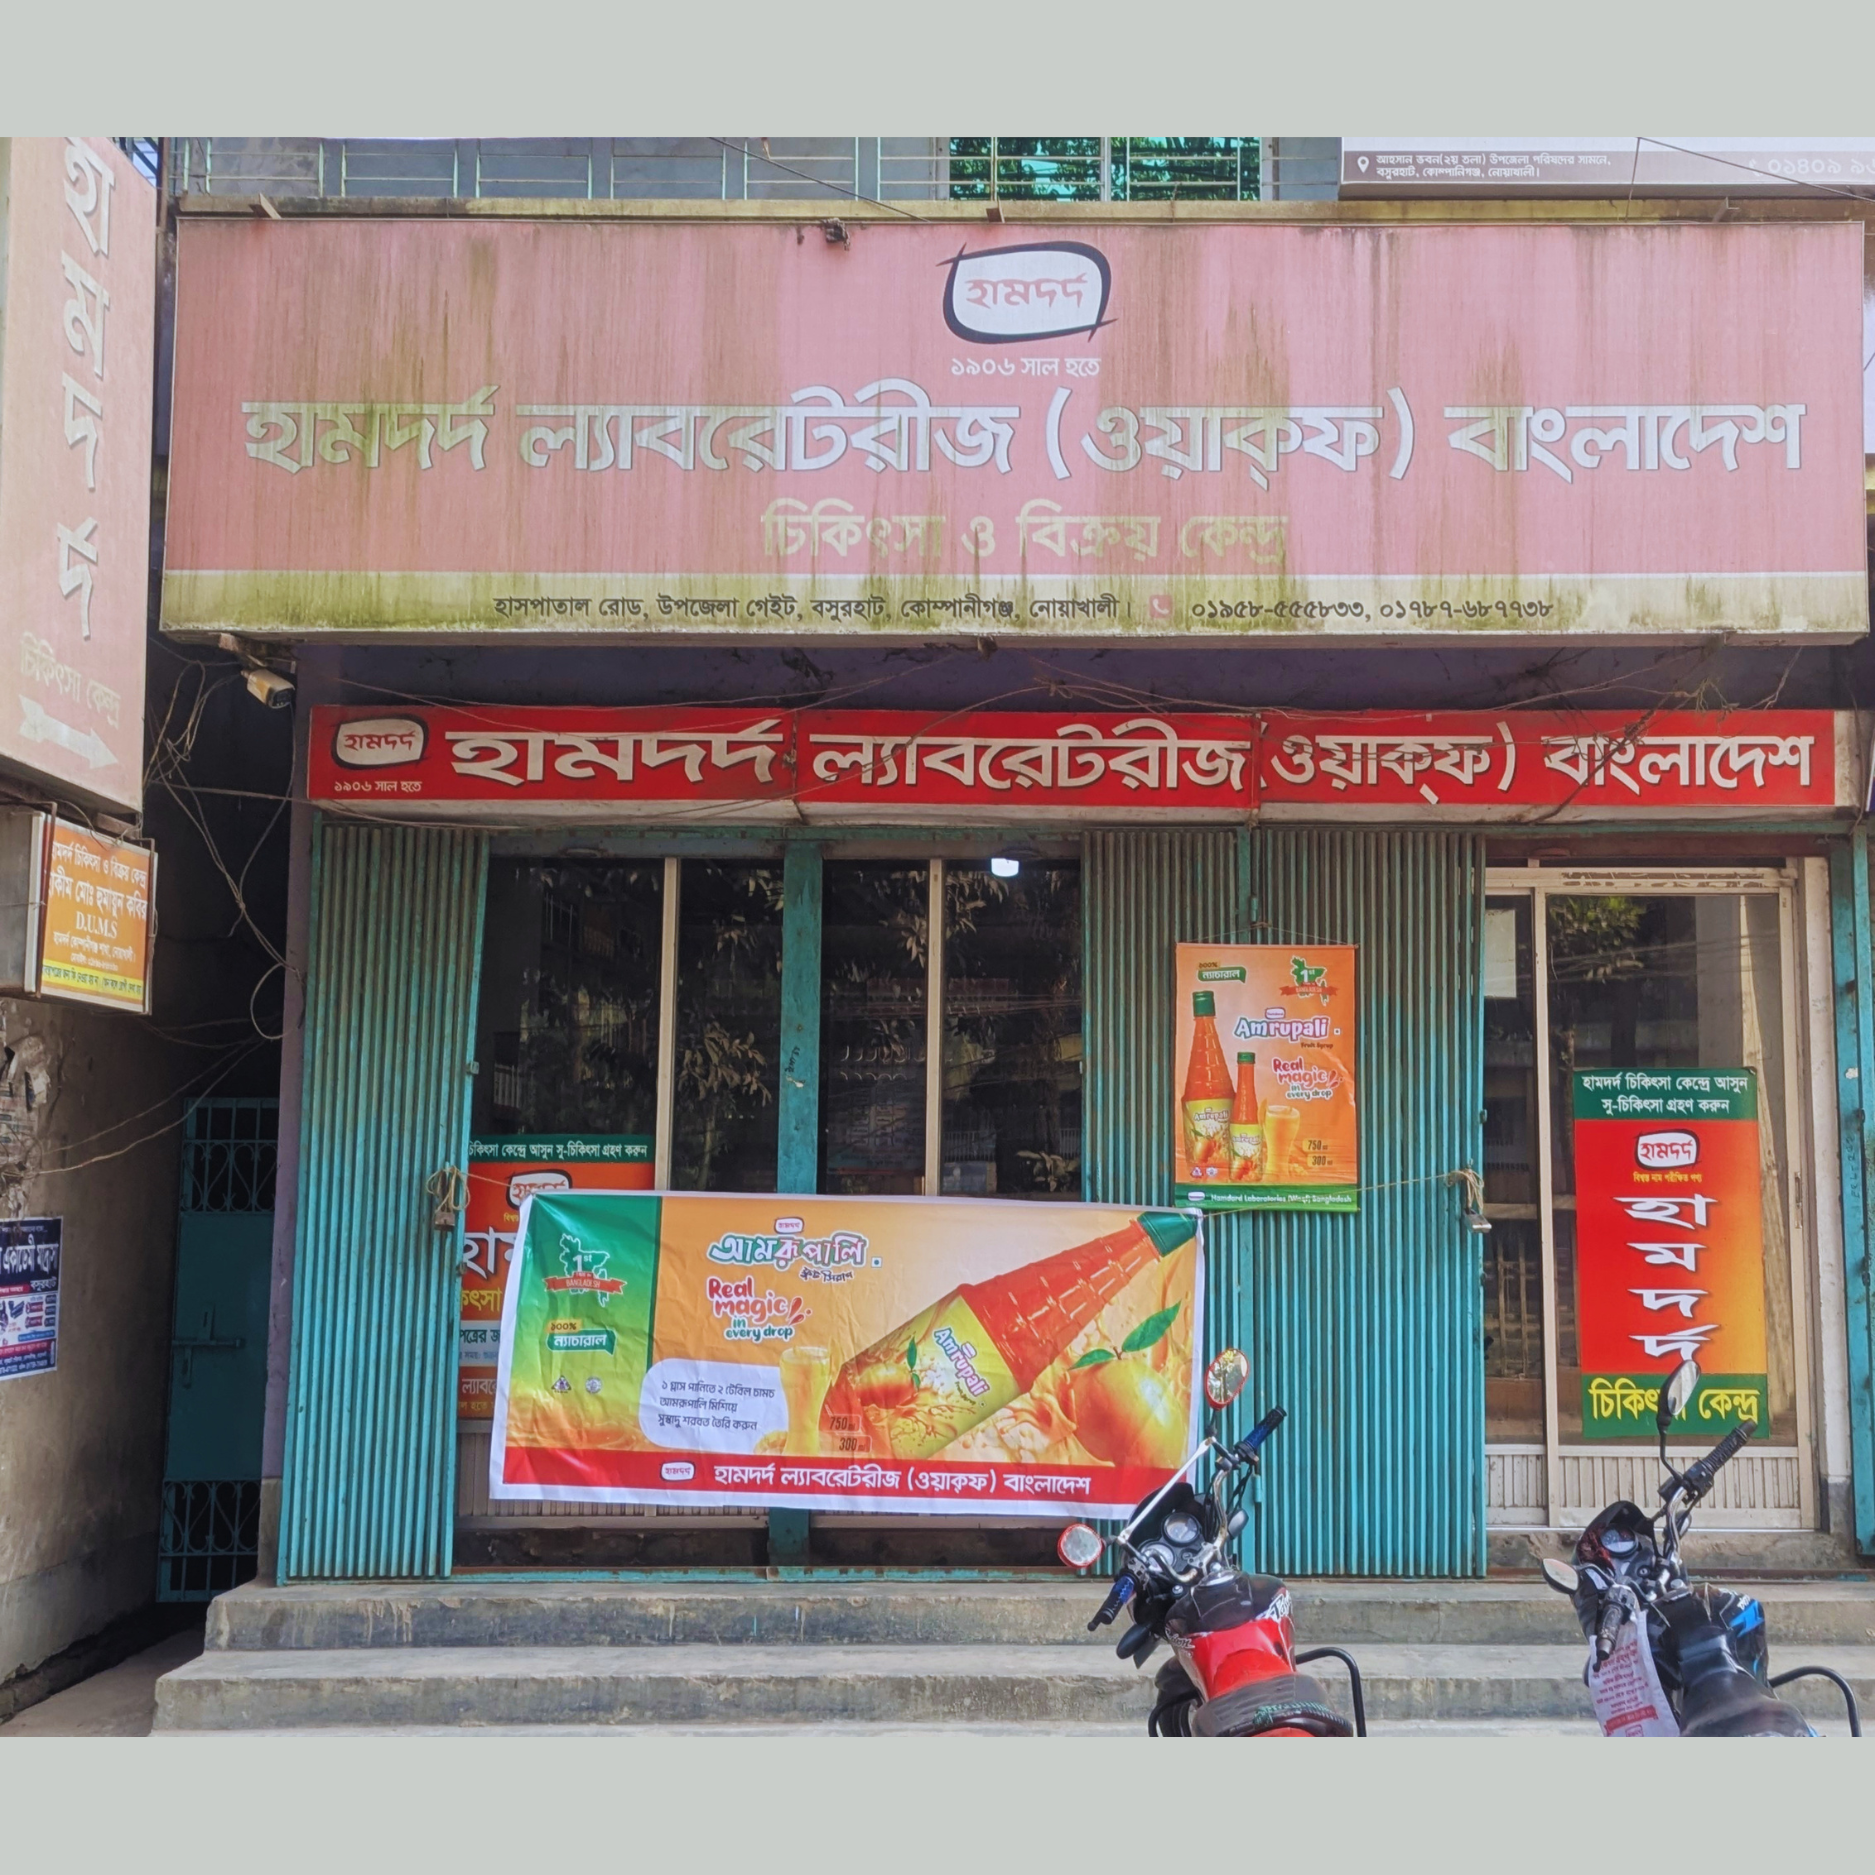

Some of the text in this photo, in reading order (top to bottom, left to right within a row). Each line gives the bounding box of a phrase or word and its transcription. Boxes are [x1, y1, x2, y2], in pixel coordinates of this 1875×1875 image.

[1376, 155, 1412, 165] আহসান
[1489, 152, 1529, 166] উপজেলা
[1533, 152, 1575, 166] পরিষদের
[1577, 154, 1611, 166] সামনে,
[1767, 158, 1842, 174] ০১৪০৯
[1376, 166, 1420, 180] বসুরহাট,
[964, 272, 1088, 310] হামদর্দ
[950, 356, 1102, 378] ১৯০৬ সাল হতে
[241, 384, 500, 475] হামদর্দ
[515, 376, 1020, 475] ল্যাবরেটরীজ
[1443, 402, 1808, 485] বাংলাদেশ
[761, 498, 1288, 565] চিকিৎসা ও বিক্রয় কেন্দ্র
[493, 594, 592, 619] হাসপাতাল
[598, 594, 649, 622] রোড,
[655, 592, 739, 618] উপজেলা
[746, 592, 803, 622] গেইট,
[811, 593, 892, 622] বসুরহাট,
[900, 592, 1021, 622] কোম্পানীগঞ্জ,
[1191, 600, 1371, 623] ০১৯৫৮-৫৫৫৮৩৩,
[1379, 599, 1554, 619] ০১৭৮৭-৬৮৭৭৩৮
[343, 730, 416, 752] হামদর্দ
[444, 718, 784, 788] হামদর্দ
[809, 717, 1252, 792] ল্যাবরেটরীজ
[1540, 735, 1815, 796] বাংলাদেশ
[334, 780, 423, 792] ১৯০৬ সাল হতে
[75, 910, 118, 940] D.U.M.S
[1202, 969, 1240, 980] ন্যাচারাল
[1235, 1017, 1329, 1042] Amrupali
[1272, 1056, 1303, 1072] Real
[1277, 1066, 1328, 1088] magic
[1581, 1071, 1748, 1093] হামদর্দ চিকিৎসা কেন্দ্রে আসুন
[1286, 1088, 1332, 1100] every drop
[1600, 1094, 1730, 1116] সু-চিকিৎসা গ্রহণ করুন
[501, 1141, 527, 1158] কেন্দ্রে
[529, 1142, 554, 1160] আসুন
[555, 1140, 600, 1161] সু-চিকিৎসা
[601, 1143, 622, 1159] গ্রহণ
[624, 1143, 648, 1158] করুন
[1307, 1139, 1322, 1151] 750
[1640, 1139, 1693, 1160] হামদর্দ
[1312, 1155, 1326, 1166] 300
[707, 1276, 754, 1300] Real
[713, 1292, 788, 1323] magic
[550, 1321, 577, 1331] ১০০%
[732, 1315, 747, 1329] in
[553, 1333, 607, 1348] ন্যাচারাল
[725, 1325, 794, 1342] every drop
[934, 1327, 991, 1397] Amrupali
[661, 1380, 776, 1399] ১ গ্লাস পানিতে ২ টেবিল চামচ
[708, 1399, 738, 1414] মিশিয়ে
[1699, 1388, 1761, 1425] কেন্দ্র
[682, 1415, 710, 1428] শরবত
[711, 1414, 731, 1430] তৈরি
[732, 1419, 758, 1431] করুন
[829, 1416, 847, 1430] 750
[839, 1437, 857, 1450] 300
[714, 1463, 775, 1485] হামদর্দ
[780, 1463, 901, 1489] ল্যাবরেটরীজ
[1003, 1473, 1091, 1494] বাংলাদেশ
